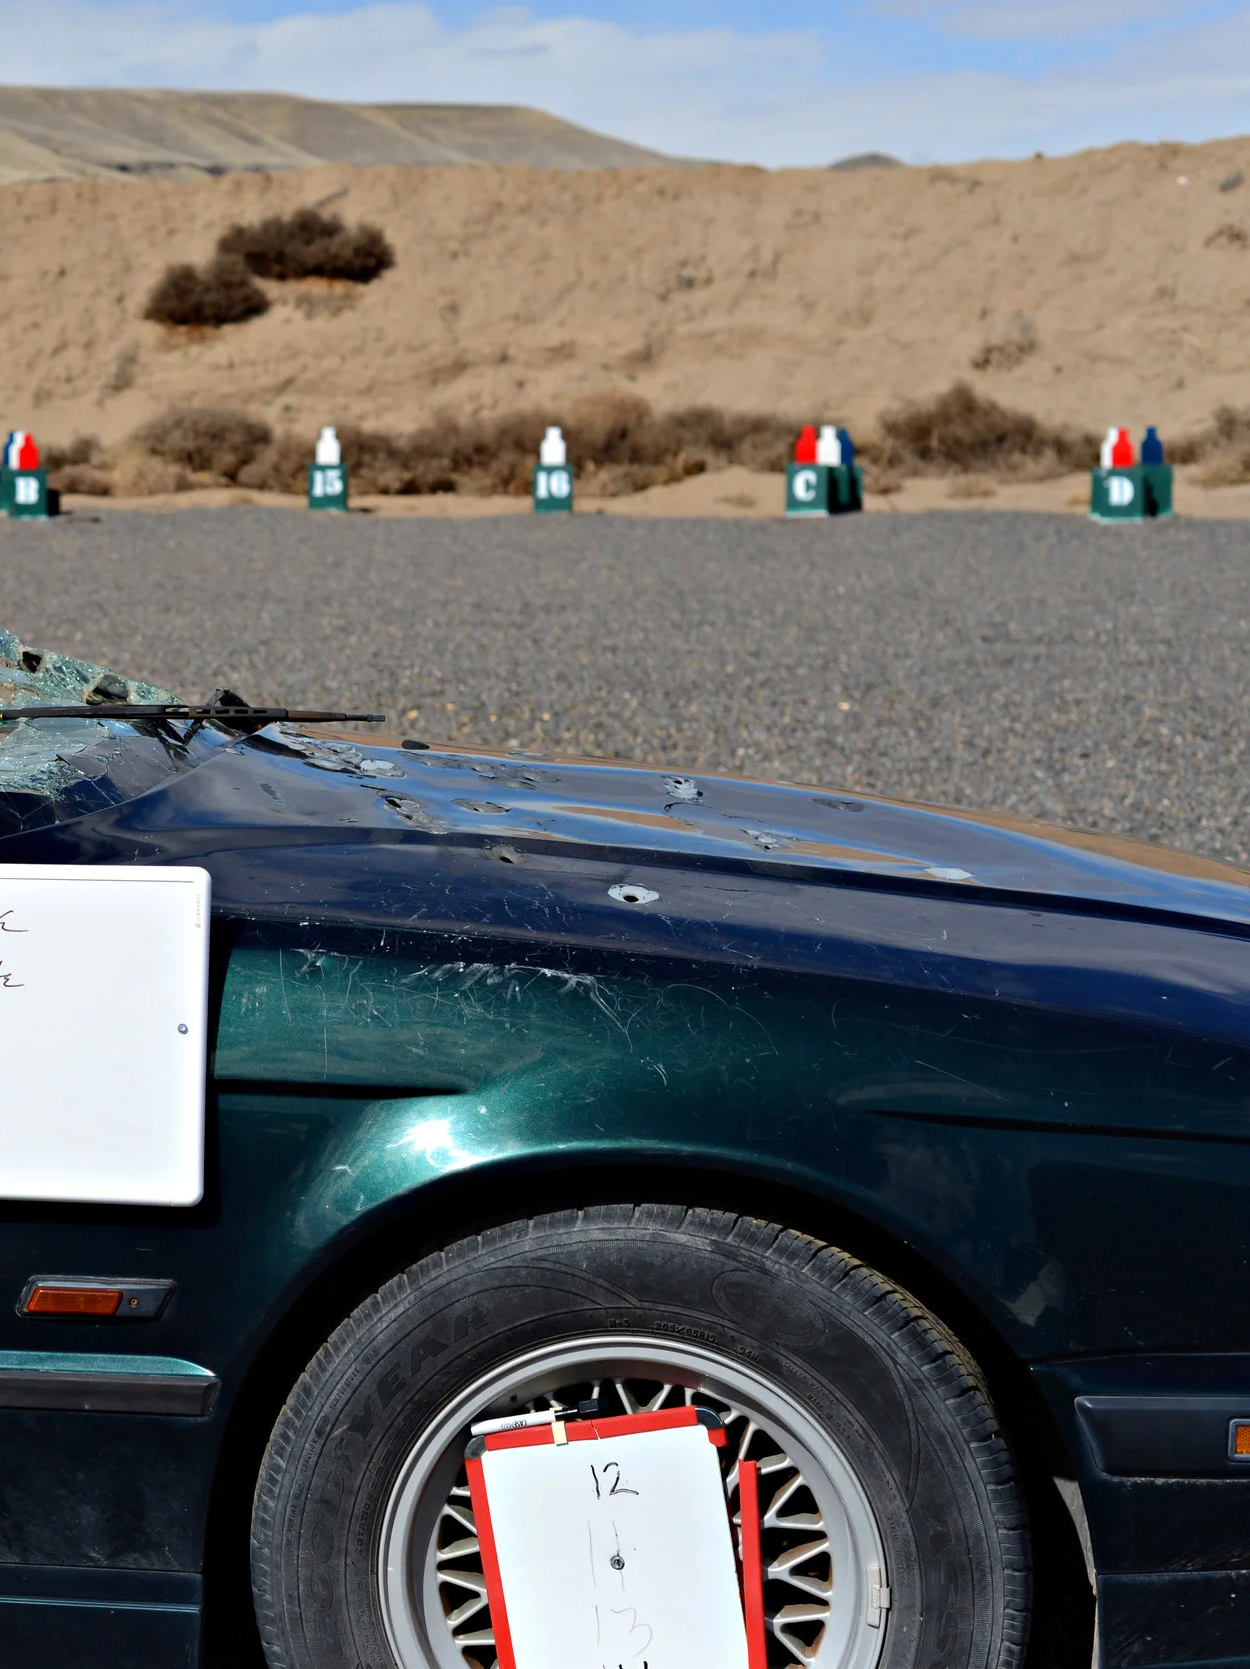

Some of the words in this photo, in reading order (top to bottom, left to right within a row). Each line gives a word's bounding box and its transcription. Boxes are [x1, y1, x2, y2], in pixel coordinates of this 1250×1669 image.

[14, 476, 40, 505] B
[311, 469, 344, 497] 15
[536, 470, 570, 499] 16
[793, 471, 817, 501] C
[1104, 475, 1135, 507] D
[590, 1461, 639, 1501] 12
